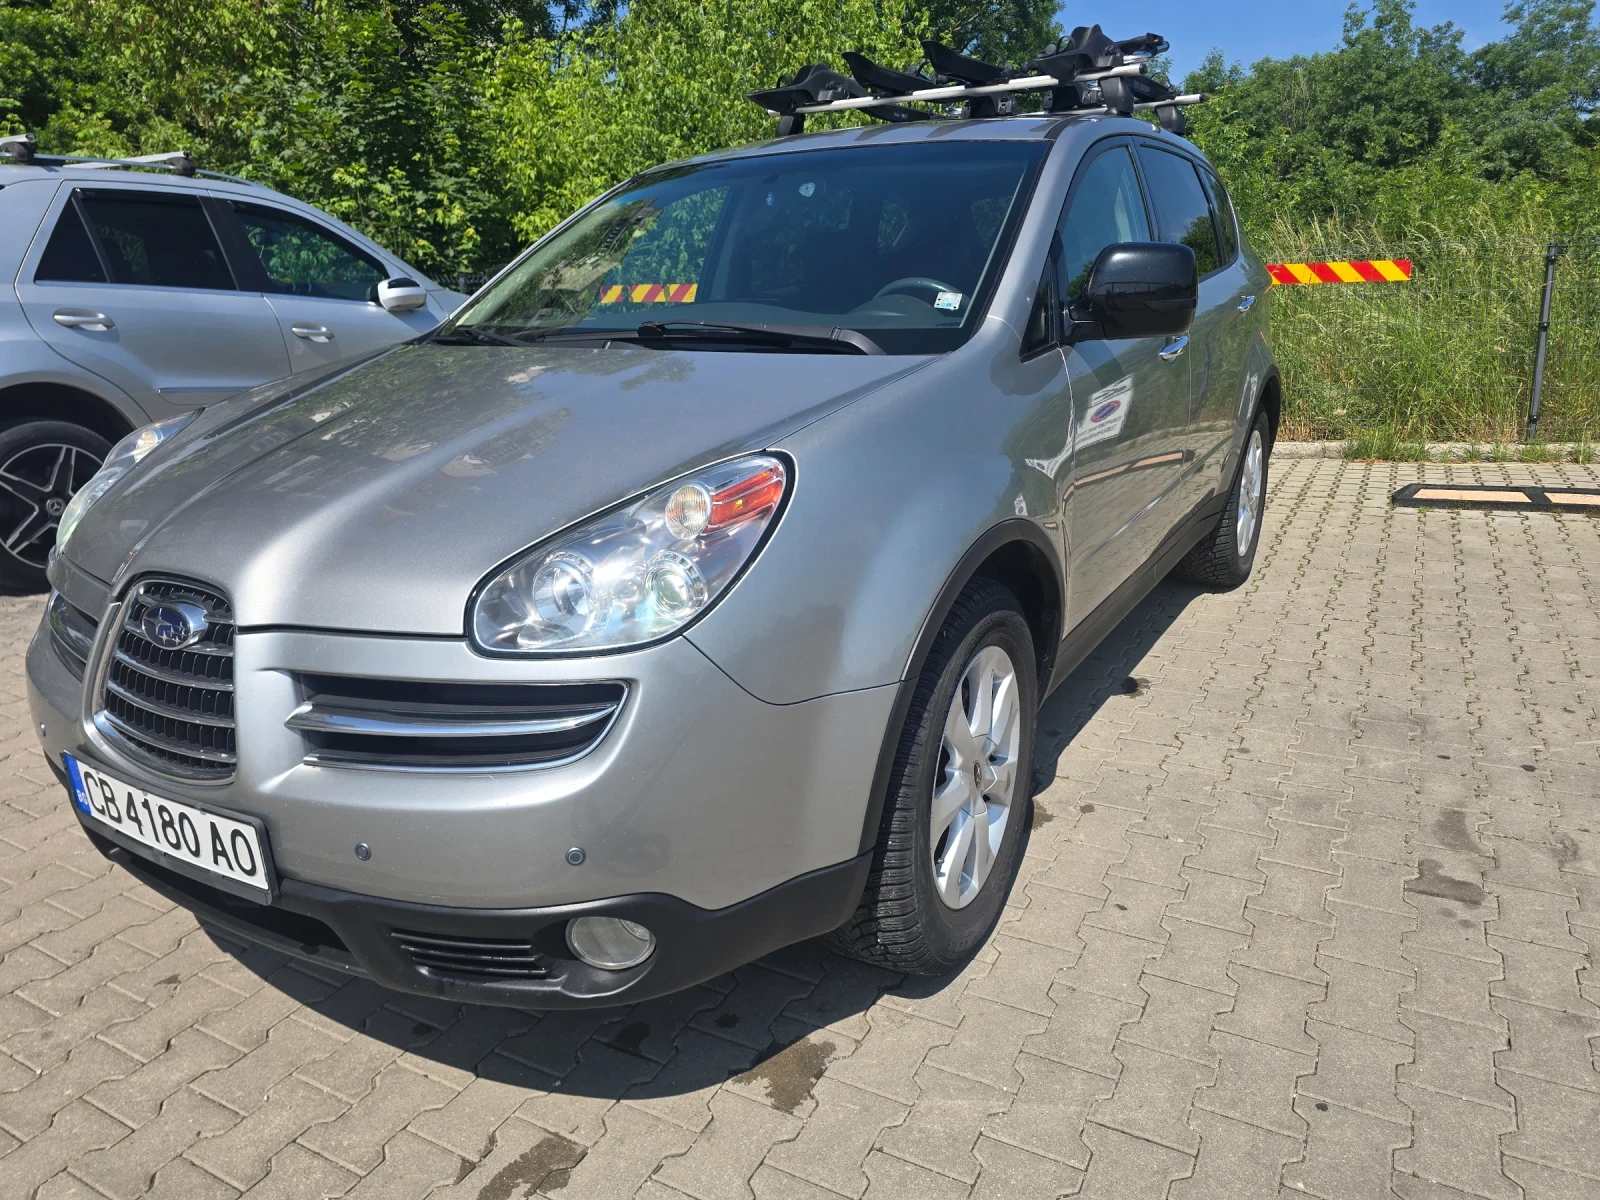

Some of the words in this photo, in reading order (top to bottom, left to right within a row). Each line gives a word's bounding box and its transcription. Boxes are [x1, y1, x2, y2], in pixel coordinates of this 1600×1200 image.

[76, 788, 88, 805] BG
[83, 771, 122, 824] CB
[126, 791, 201, 858] 4180
[209, 821, 257, 876] AO
